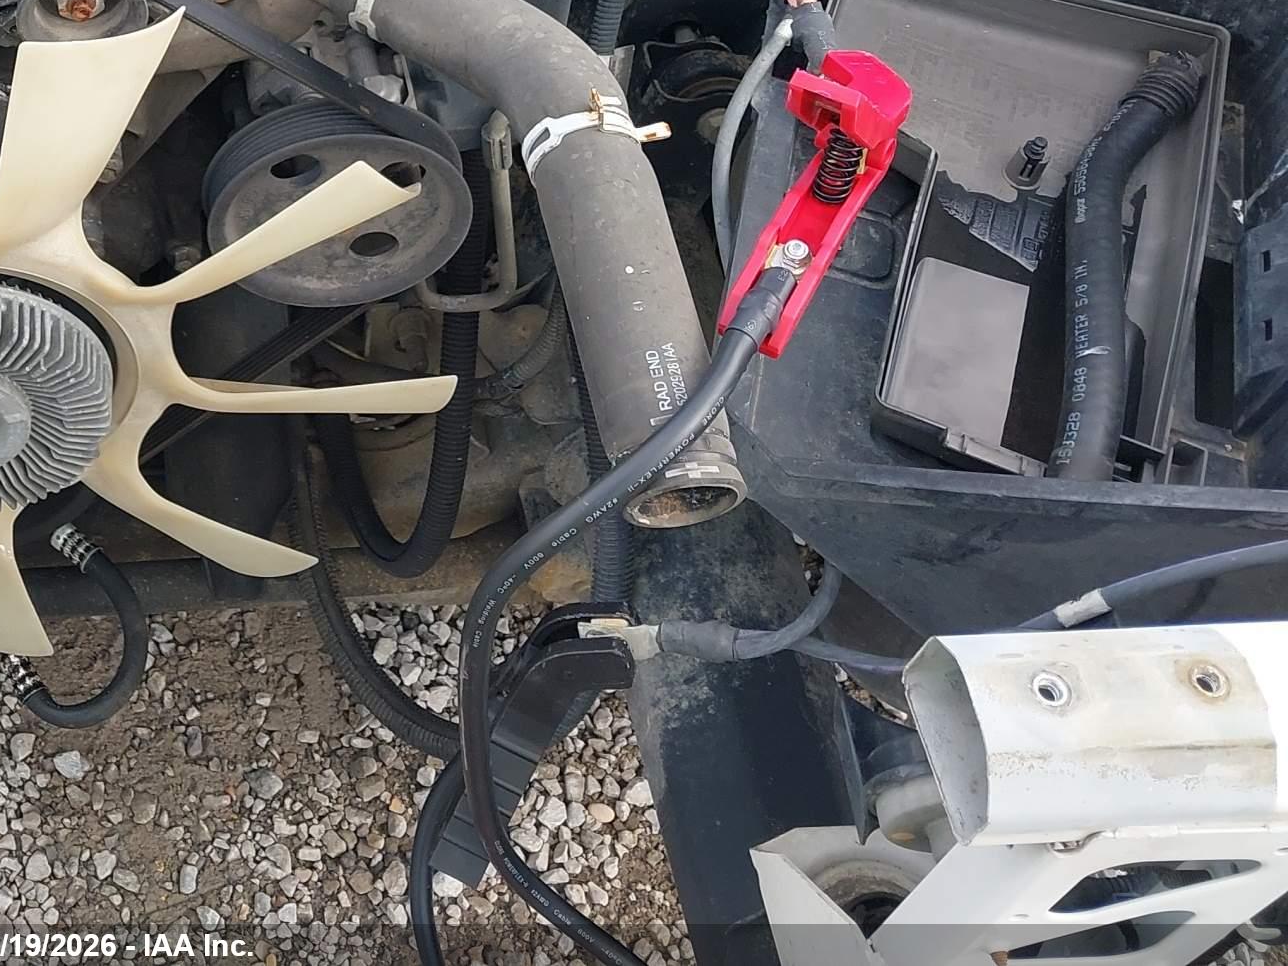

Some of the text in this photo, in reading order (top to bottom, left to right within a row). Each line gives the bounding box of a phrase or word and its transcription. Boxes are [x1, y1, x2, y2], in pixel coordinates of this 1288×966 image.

[645, 350, 673, 412] RAD END
[1071, 366, 1088, 403] 0848
[550, 527, 578, 547] Cable
[522, 551, 546, 570] 600V
